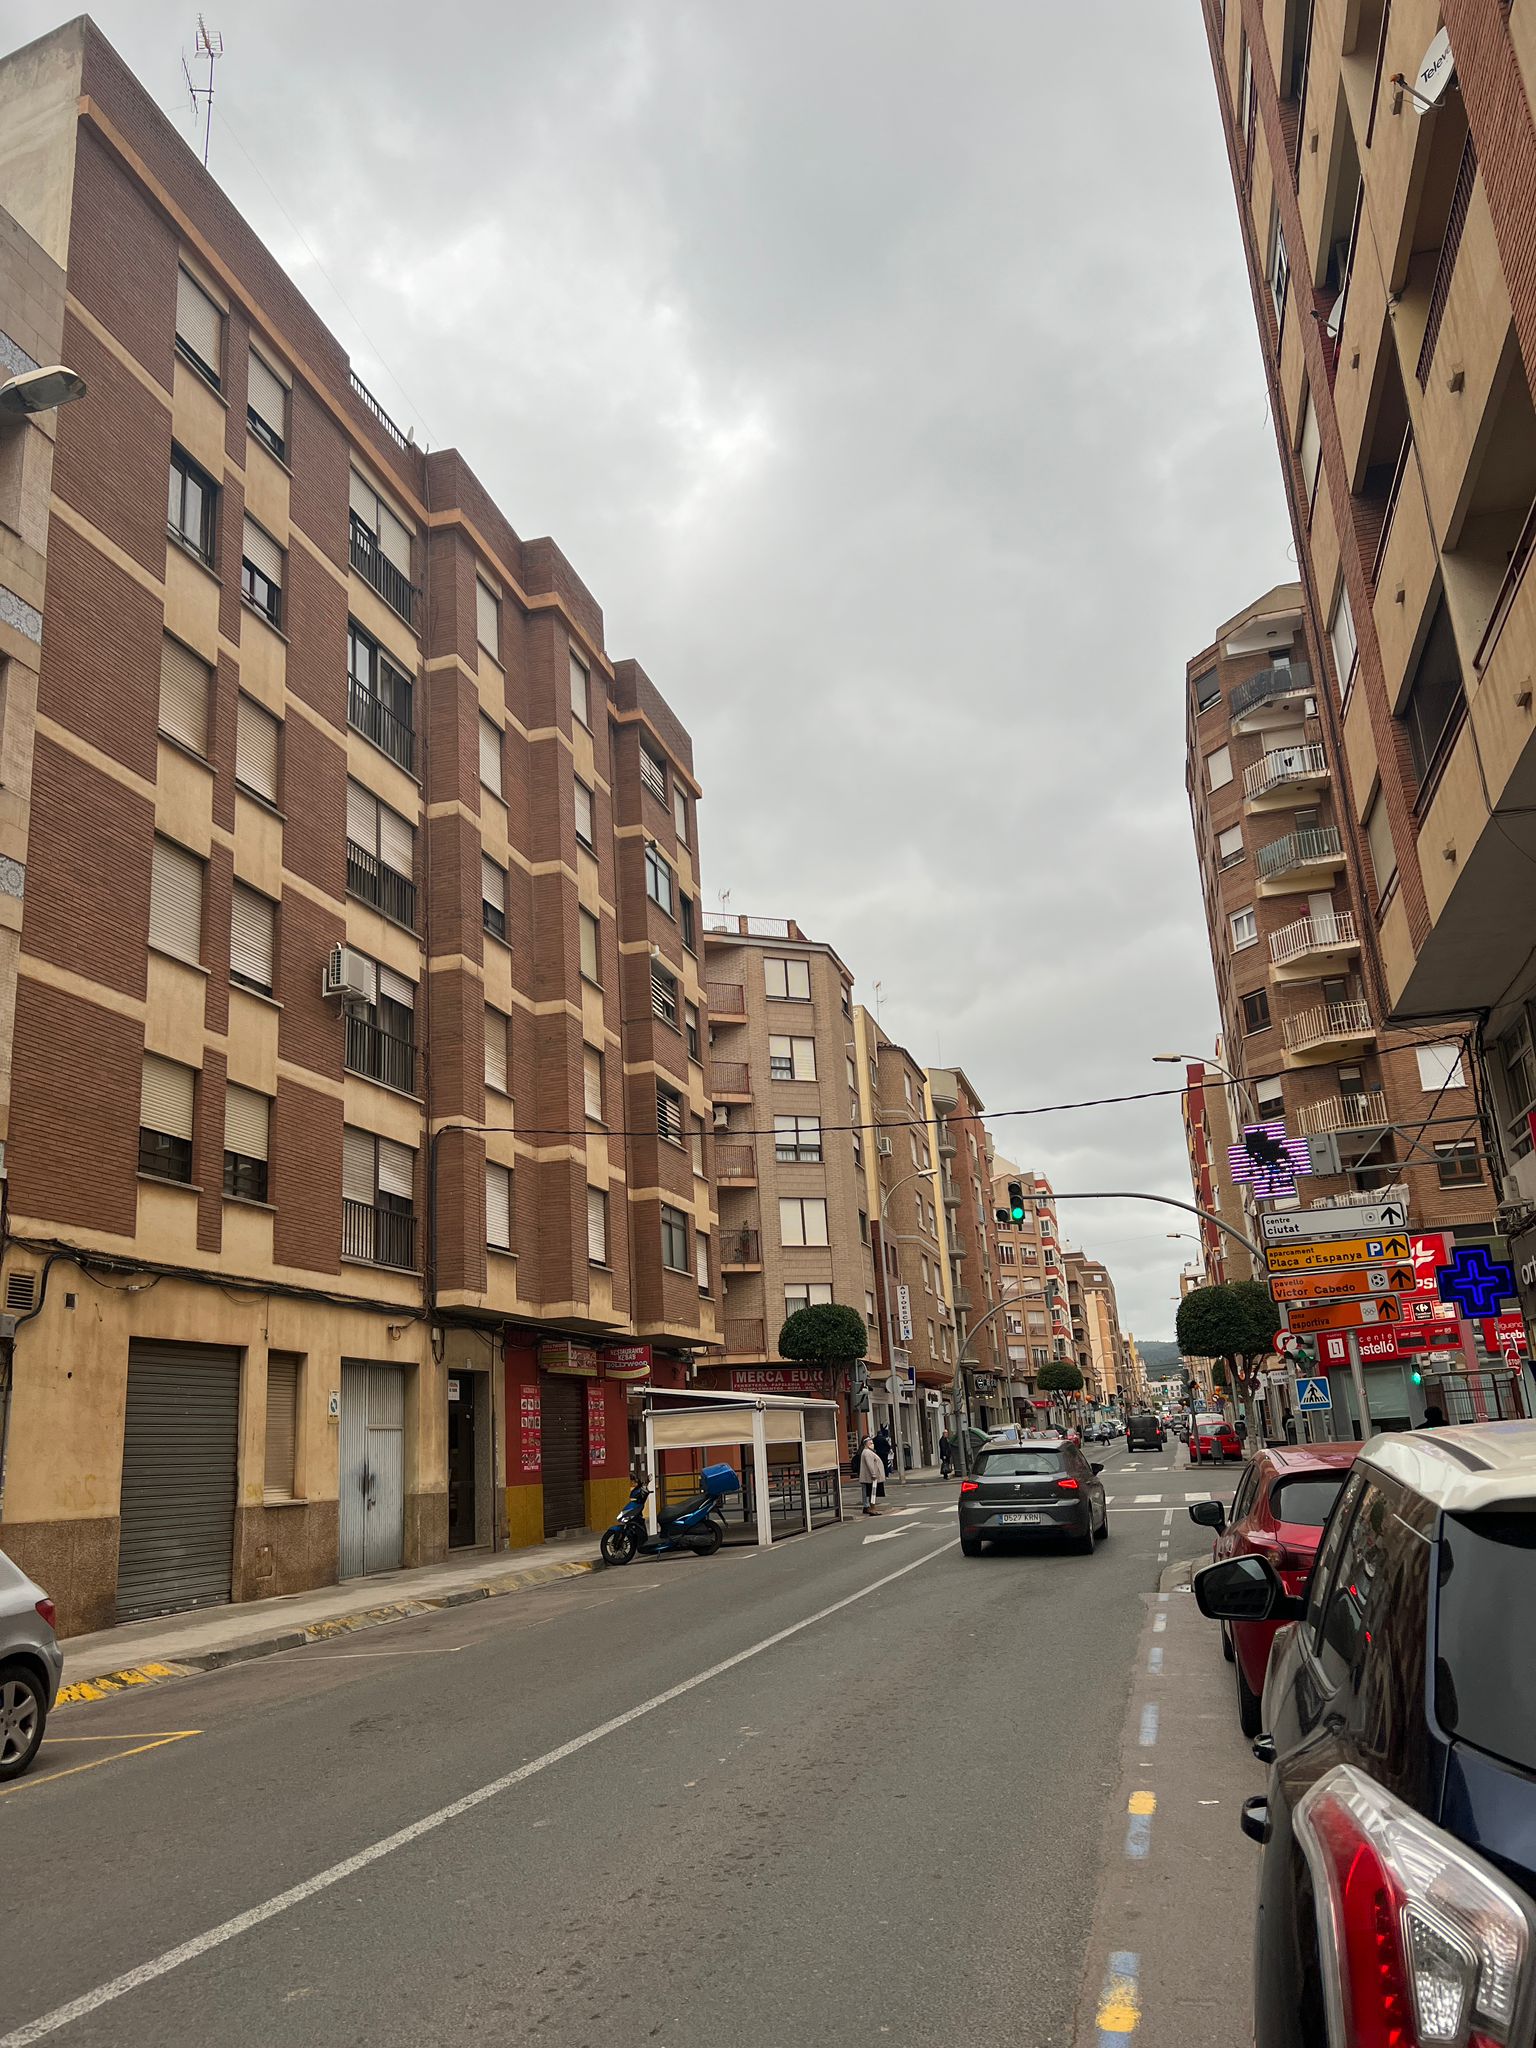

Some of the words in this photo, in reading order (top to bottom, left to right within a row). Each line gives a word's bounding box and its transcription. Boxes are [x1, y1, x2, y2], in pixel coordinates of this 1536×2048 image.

[1266, 1217, 1290, 1225] centre
[1267, 1224, 1300, 1235] ciutat
[1269, 1247, 1314, 1258] aparcament
[1270, 1255, 1299, 1269] Plaça
[1305, 1252, 1362, 1265] d'Espanya
[1314, 1284, 1356, 1295] Cabedo
[900, 1286, 910, 1339] AUTOESCUELA
[1291, 1317, 1330, 1330] esportiva
[736, 1371, 784, 1383] MERCA
[1003, 1513, 1022, 1522] 0527
[1024, 1513, 1039, 1521] KRN
